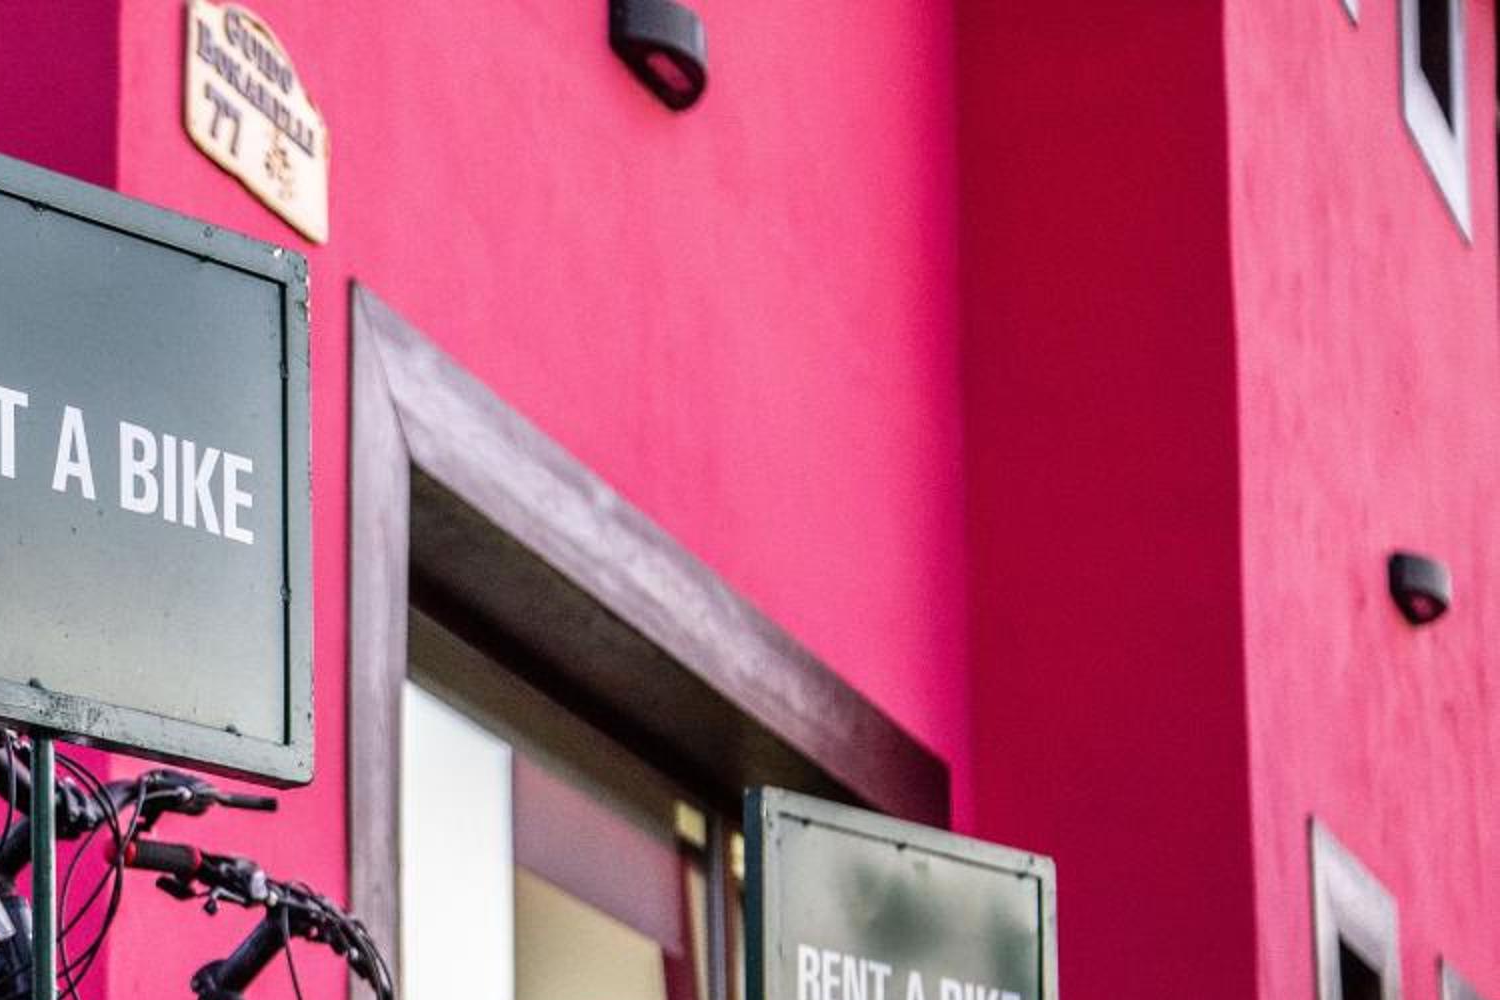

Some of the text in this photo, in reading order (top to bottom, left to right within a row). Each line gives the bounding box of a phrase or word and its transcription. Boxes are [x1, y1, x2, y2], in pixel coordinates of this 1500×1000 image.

[203, 82, 243, 157] 77
[51, 404, 97, 501] A
[119, 420, 255, 546] BIKE
